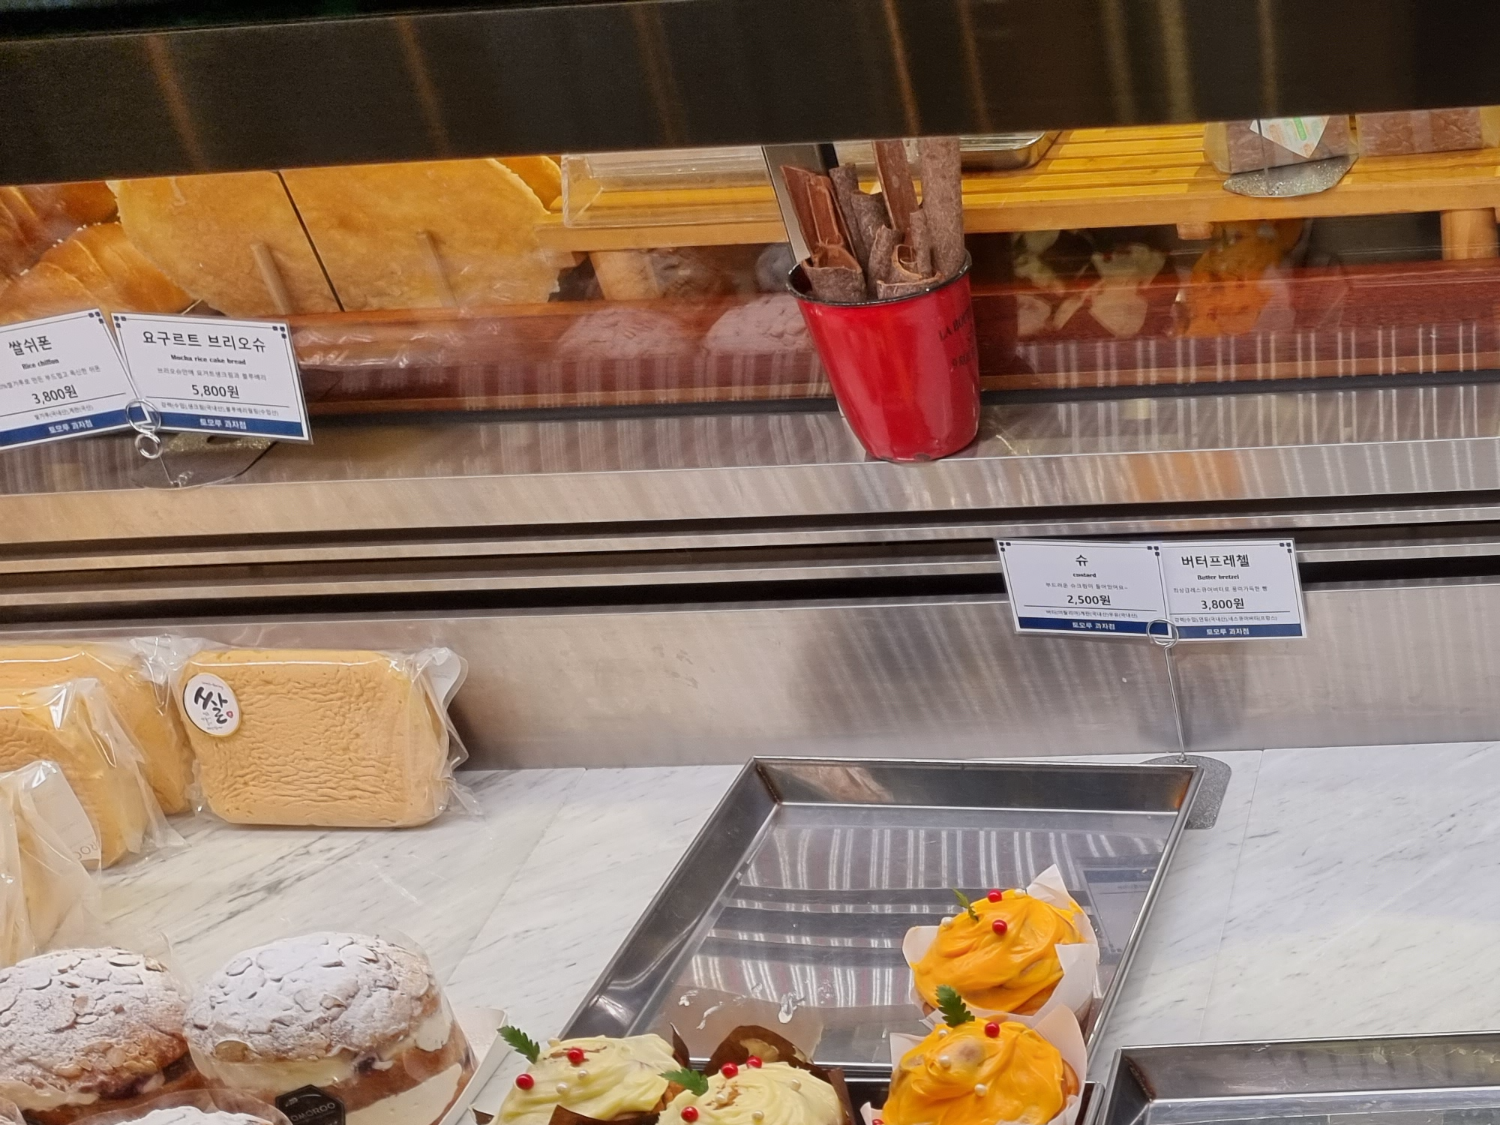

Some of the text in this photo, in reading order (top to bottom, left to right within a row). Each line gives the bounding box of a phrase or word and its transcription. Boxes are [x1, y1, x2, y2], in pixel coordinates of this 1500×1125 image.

[9, 336, 52, 356] 쌀쉬폰
[143, 331, 266, 353] 요구르트 브리오슈
[32, 385, 78, 405] 3,800원
[191, 384, 240, 399] 5,800원
[48, 420, 93, 433] 토모루 과자점
[200, 418, 247, 430] 토모루 과자점
[1076, 555, 1088, 567] 슈
[1181, 554, 1250, 568] 버터프레첼
[1067, 595, 1111, 606] 2,500원
[1201, 598, 1245, 611] 3,800원
[1095, 623, 1116, 631] 과자점
[194, 686, 229, 725] 쌀
[290, 1102, 336, 1122] OMOROO
